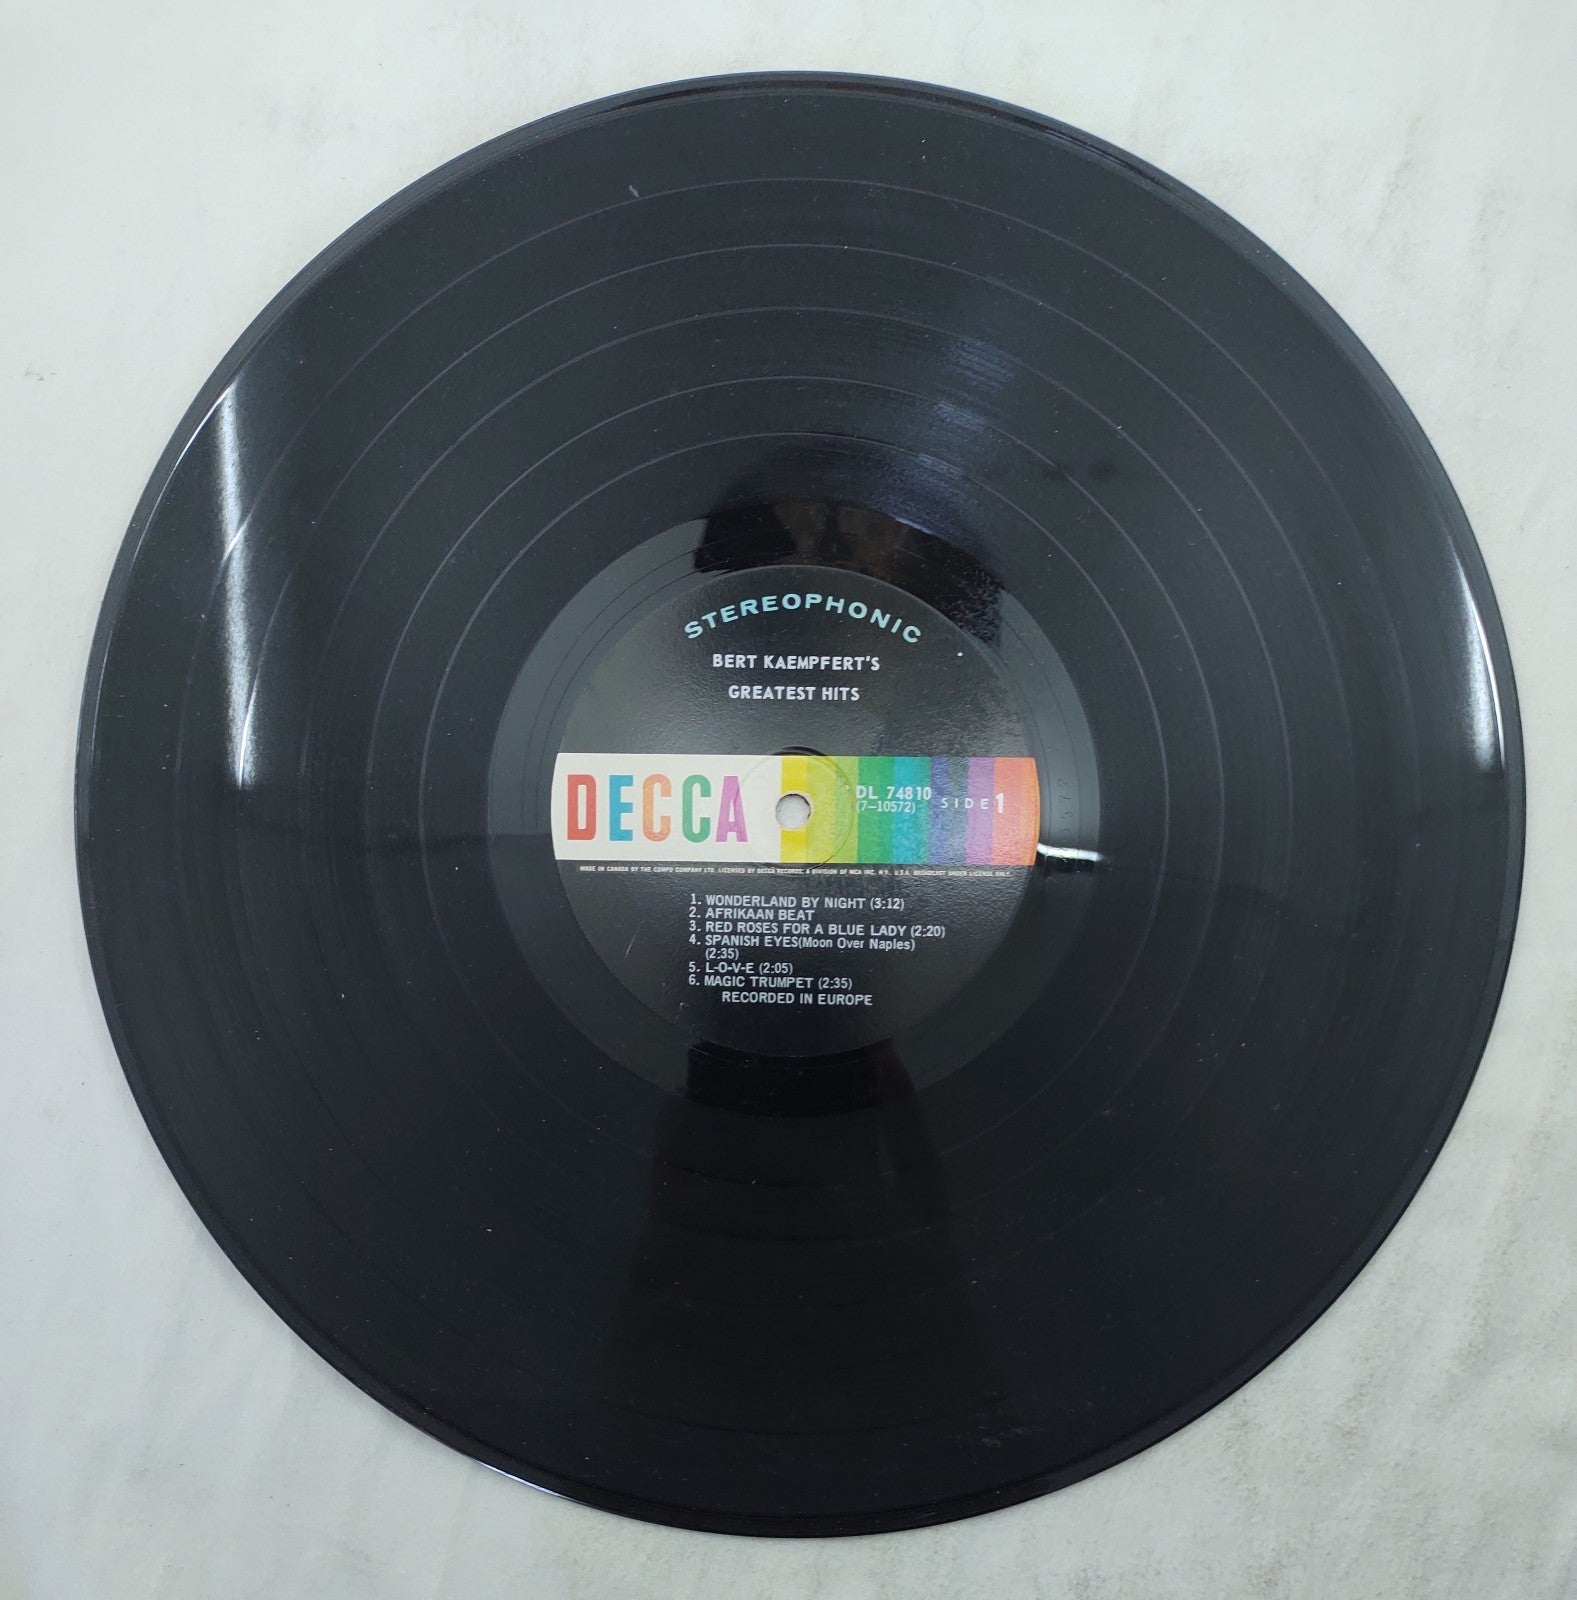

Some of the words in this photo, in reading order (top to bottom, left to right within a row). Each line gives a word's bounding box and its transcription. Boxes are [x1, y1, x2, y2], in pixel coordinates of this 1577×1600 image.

[684, 593, 921, 643] STEREOPHONIC
[712, 654, 757, 668] BERT
[763, 655, 880, 671] KAEMPFERT'S
[728, 685, 816, 700] GREATEST
[822, 686, 860, 701] HITS
[856, 786, 876, 800] DL
[886, 786, 932, 800] 74810
[567, 773, 748, 843] DECCA
[941, 798, 989, 810] SIDE
[996, 793, 1005, 813] 1
[691, 894, 701, 905] 1.
[706, 895, 796, 908] WONDERLAND
[802, 897, 819, 908] BY
[825, 898, 866, 909] NIGHT
[870, 898, 904, 910] (3:12)
[689, 908, 701, 918] 2.
[705, 908, 774, 920] AFRIKAAN
[779, 910, 814, 921] BEAT
[689, 921, 701, 931] 3.
[706, 922, 732, 932] RED
[737, 922, 778, 933] ROSES
[783, 923, 810, 934] FOR
[814, 924, 823, 934] A
[829, 924, 864, 935] BLUE
[871, 925, 906, 936] LADY
[911, 925, 945, 938] (2:20)
[689, 935, 701, 945] 4.
[705, 935, 759, 946] SPANISH
[838, 938, 864, 949] Over
[869, 939, 915, 951] Naples)
[705, 948, 739, 960] (2:35)
[689, 962, 700, 972] 5.
[706, 963, 754, 973] L-O-V-E
[759, 963, 793, 975] (2:05)
[689, 975, 700, 986] 6.
[704, 976, 745, 987] MAGIC
[750, 976, 813, 988] TRUMPET
[818, 977, 853, 990] (2:35)
[722, 992, 794, 1003] RECORDED
[800, 993, 813, 1004] IN
[818, 994, 873, 1005] EUROPE
